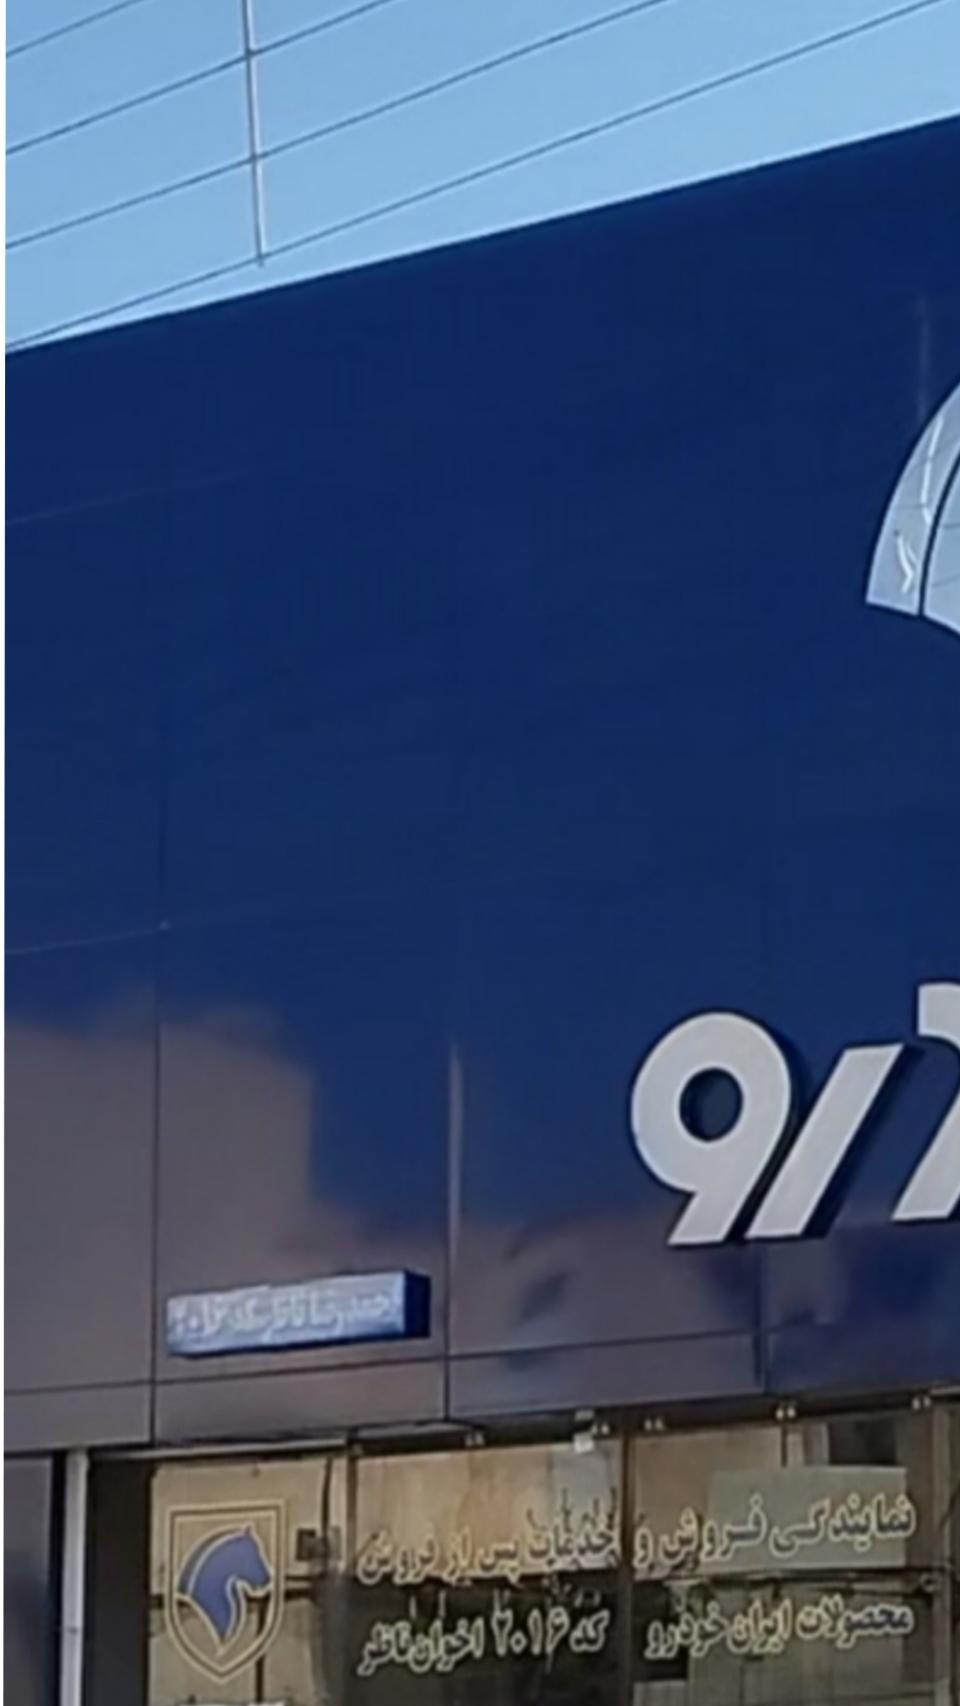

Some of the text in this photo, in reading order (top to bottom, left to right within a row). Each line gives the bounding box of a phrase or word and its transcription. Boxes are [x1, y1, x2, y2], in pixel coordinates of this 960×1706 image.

[356, 1492, 916, 1585] نمایندگی فروش و خدمات پس از فروش
[356, 1592, 914, 1677] محصولات ایران خودرو کد ۲۰۱۶ اخوان ناظر
